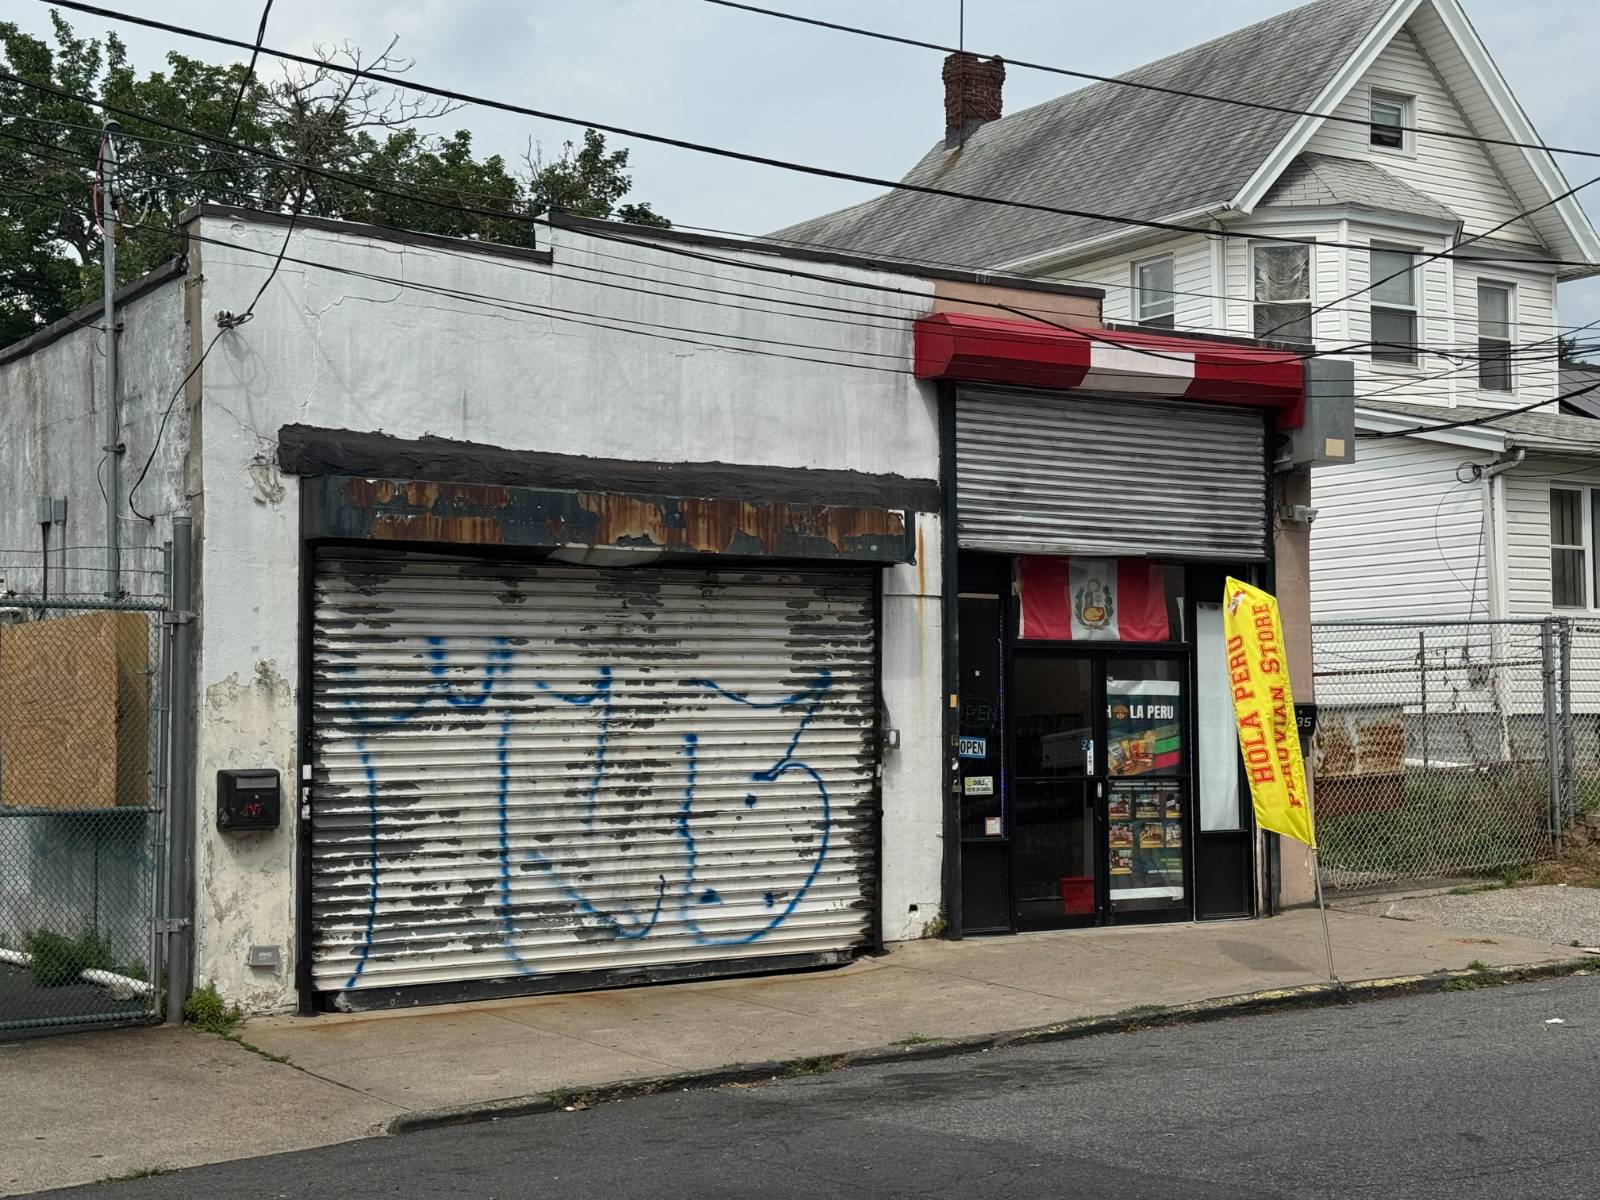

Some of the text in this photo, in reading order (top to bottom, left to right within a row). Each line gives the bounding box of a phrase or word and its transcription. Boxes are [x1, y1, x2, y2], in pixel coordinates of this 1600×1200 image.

[1147, 705, 1174, 719] PERU
[1228, 634, 1276, 784] HOLA PERU
[1252, 602, 1302, 808] PERUVIAN STORE
[960, 740, 984, 755] OPEN
